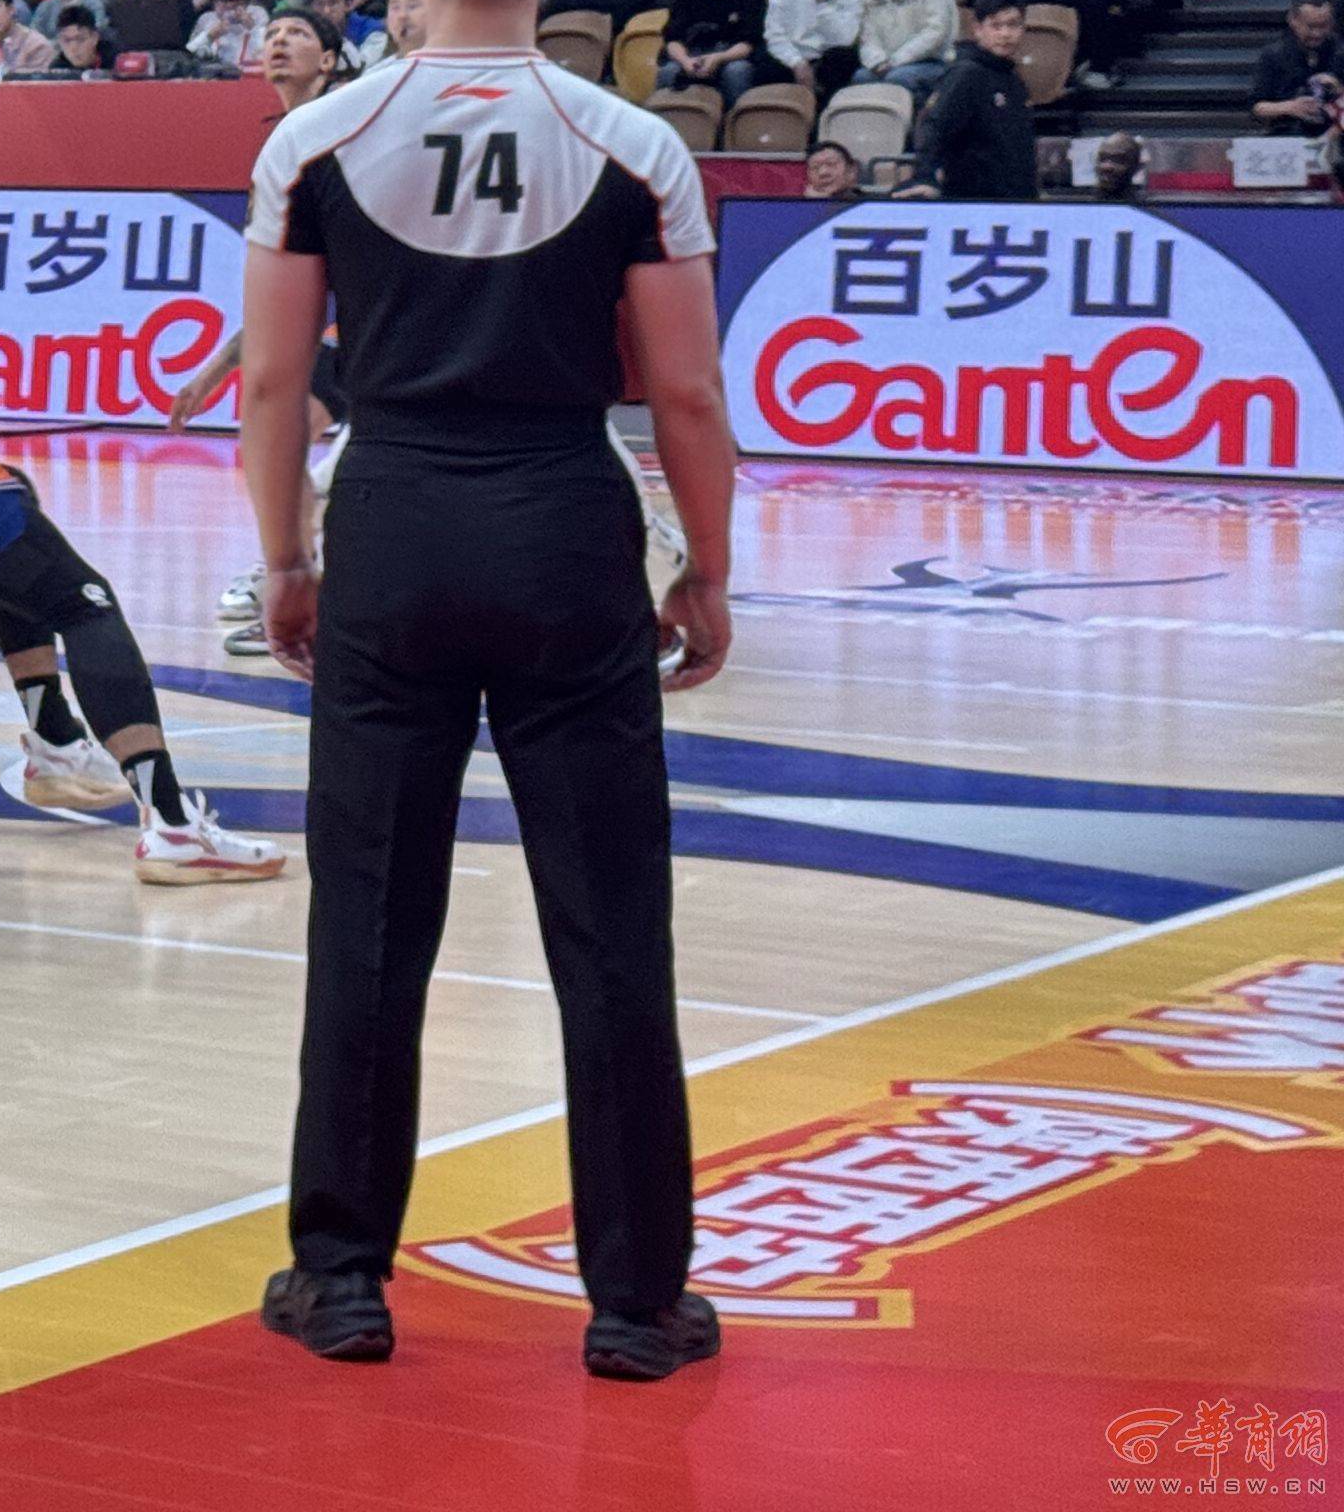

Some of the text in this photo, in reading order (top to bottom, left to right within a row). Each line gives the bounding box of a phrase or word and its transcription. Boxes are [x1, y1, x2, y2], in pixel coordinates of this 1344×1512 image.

[423, 131, 523, 216] 74
[830, 224, 1176, 320] 百岁山
[754, 315, 1300, 469] Ganten
